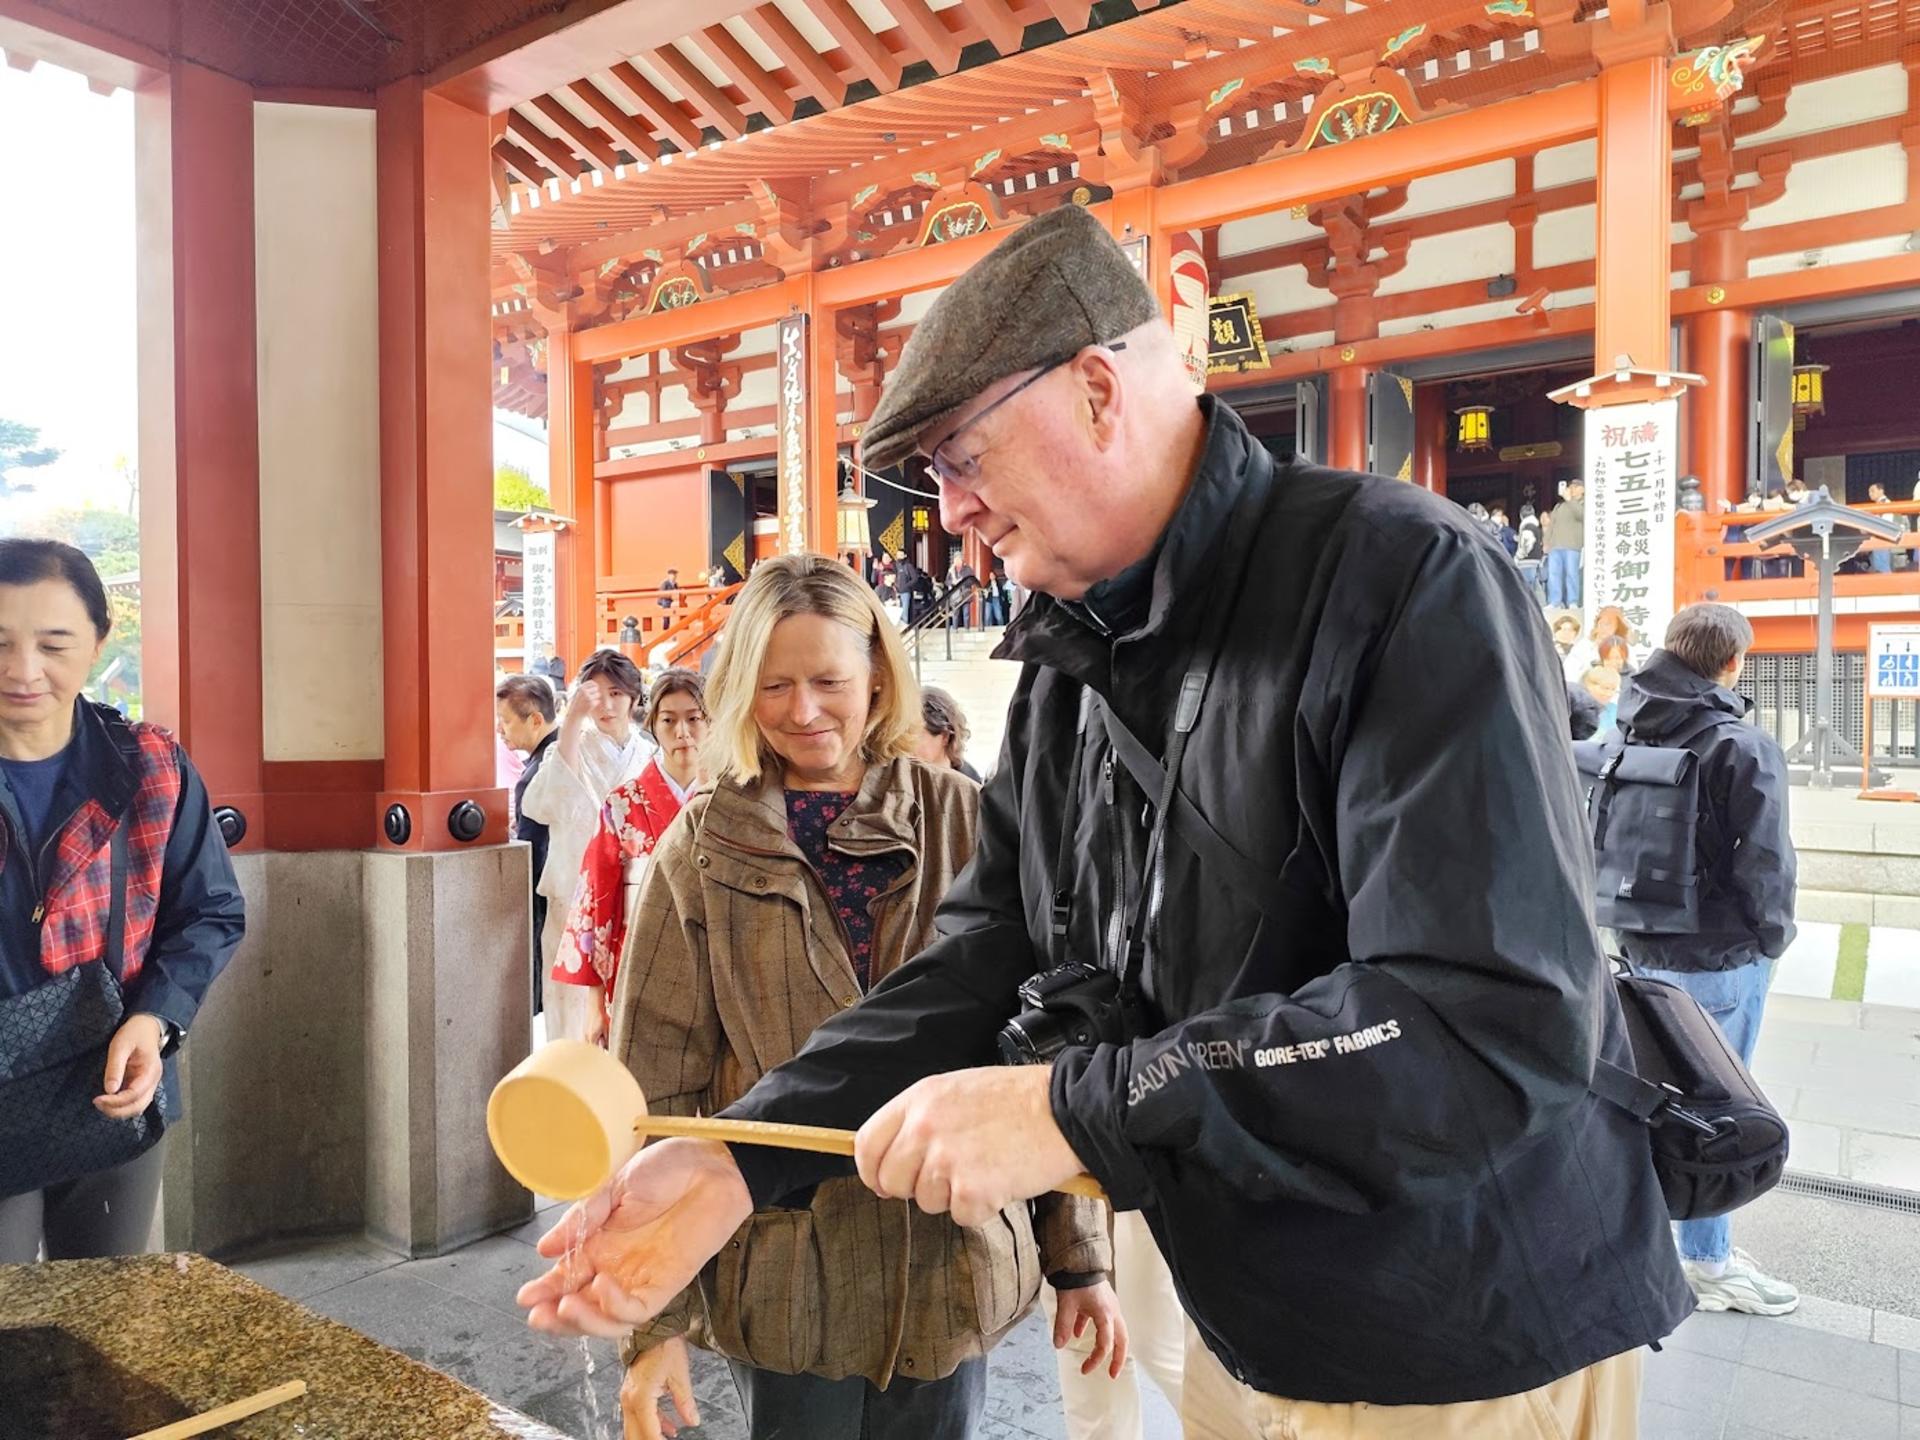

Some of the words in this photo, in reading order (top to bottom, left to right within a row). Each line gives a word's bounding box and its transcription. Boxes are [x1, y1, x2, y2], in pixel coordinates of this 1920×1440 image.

[1614, 450, 1651, 516] 七五三
[1615, 521, 1632, 557] 延命
[1633, 519, 1650, 556] 息災
[1334, 1019, 1401, 1055] FABRICS
